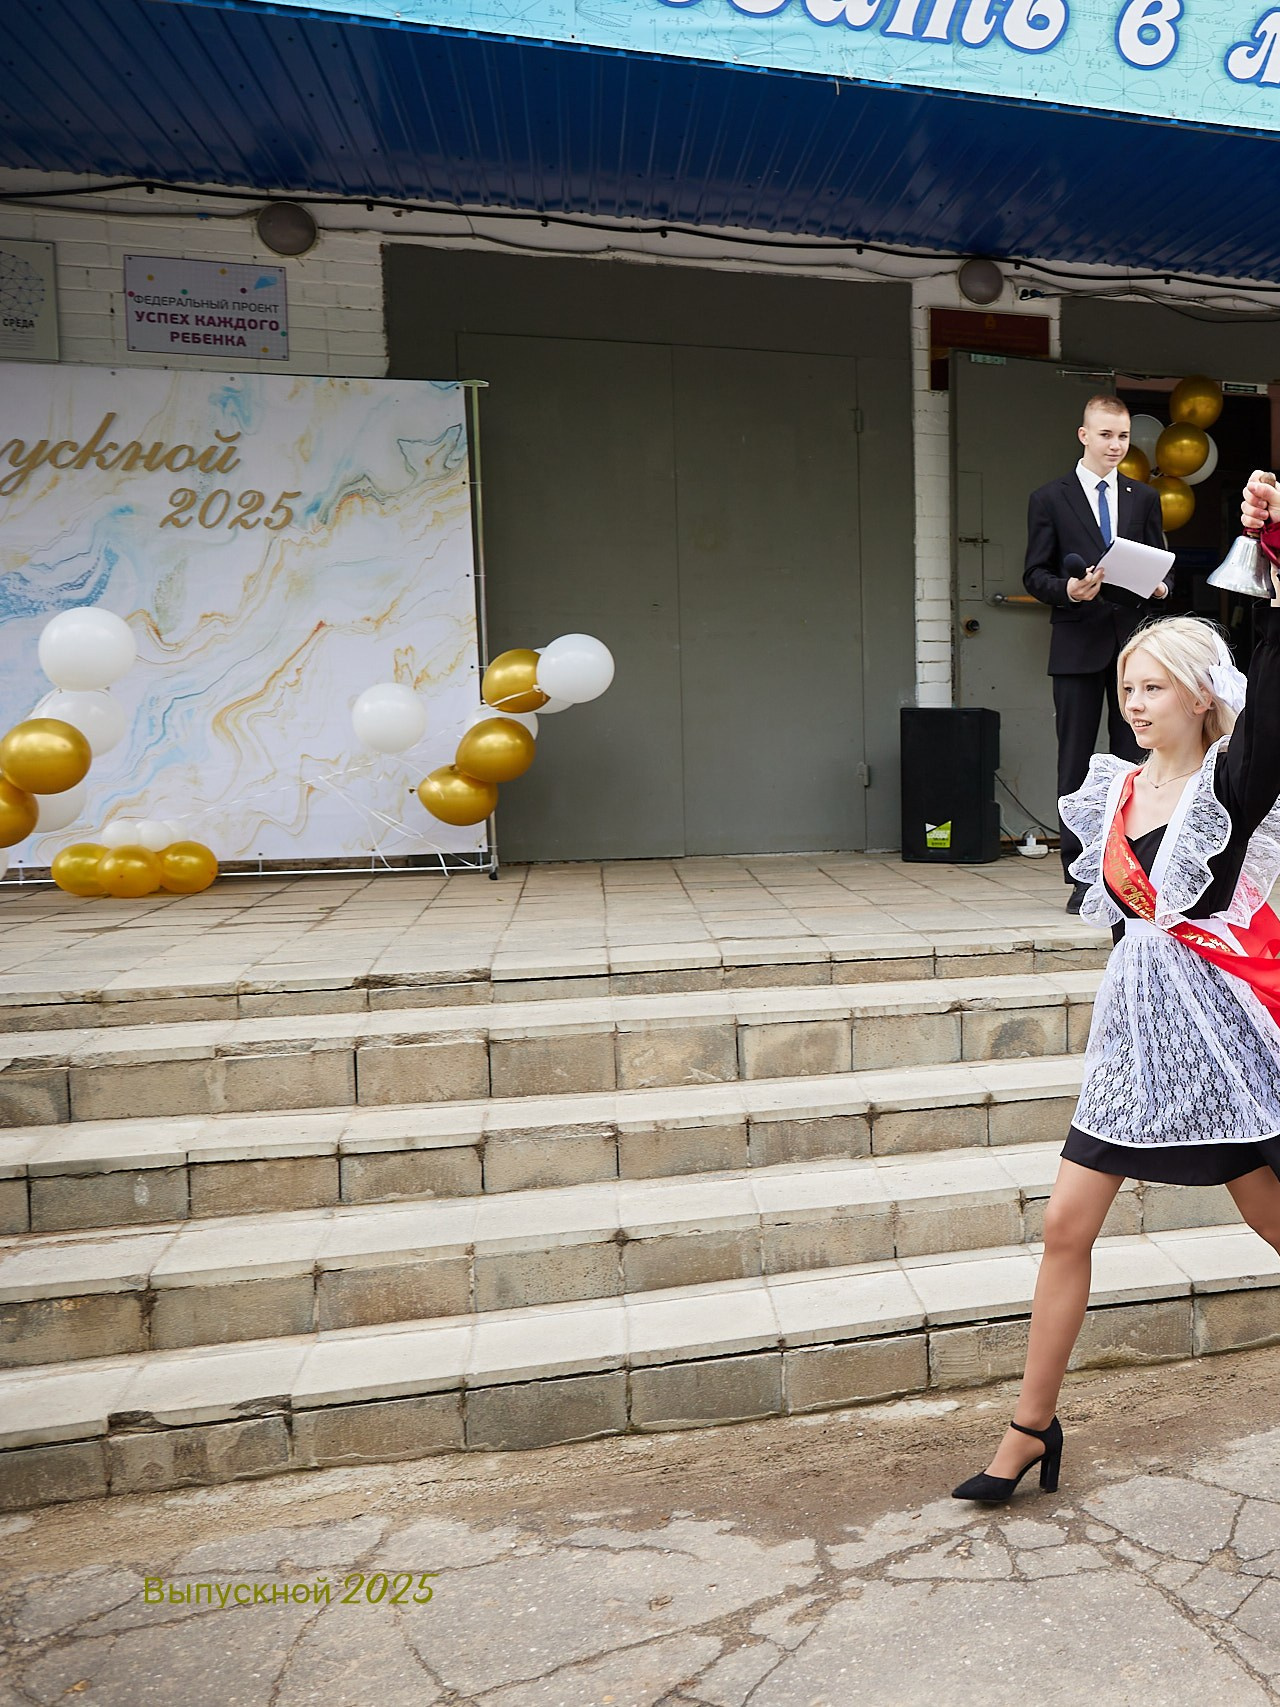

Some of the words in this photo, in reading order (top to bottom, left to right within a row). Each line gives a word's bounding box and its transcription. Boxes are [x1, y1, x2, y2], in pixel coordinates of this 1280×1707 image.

[1116, 0, 1184, 69] в
[133, 294, 229, 311] ФЕДЕРАЛЬНЫЙ
[231, 301, 280, 314] ПРОЕКТ
[2, 318, 35, 328] СРЕДА
[134, 310, 190, 326] УСПЕХ
[195, 314, 280, 332] КАЖДОГО
[169, 331, 247, 347] РЕБЕНКА
[159, 487, 302, 530] 2025
